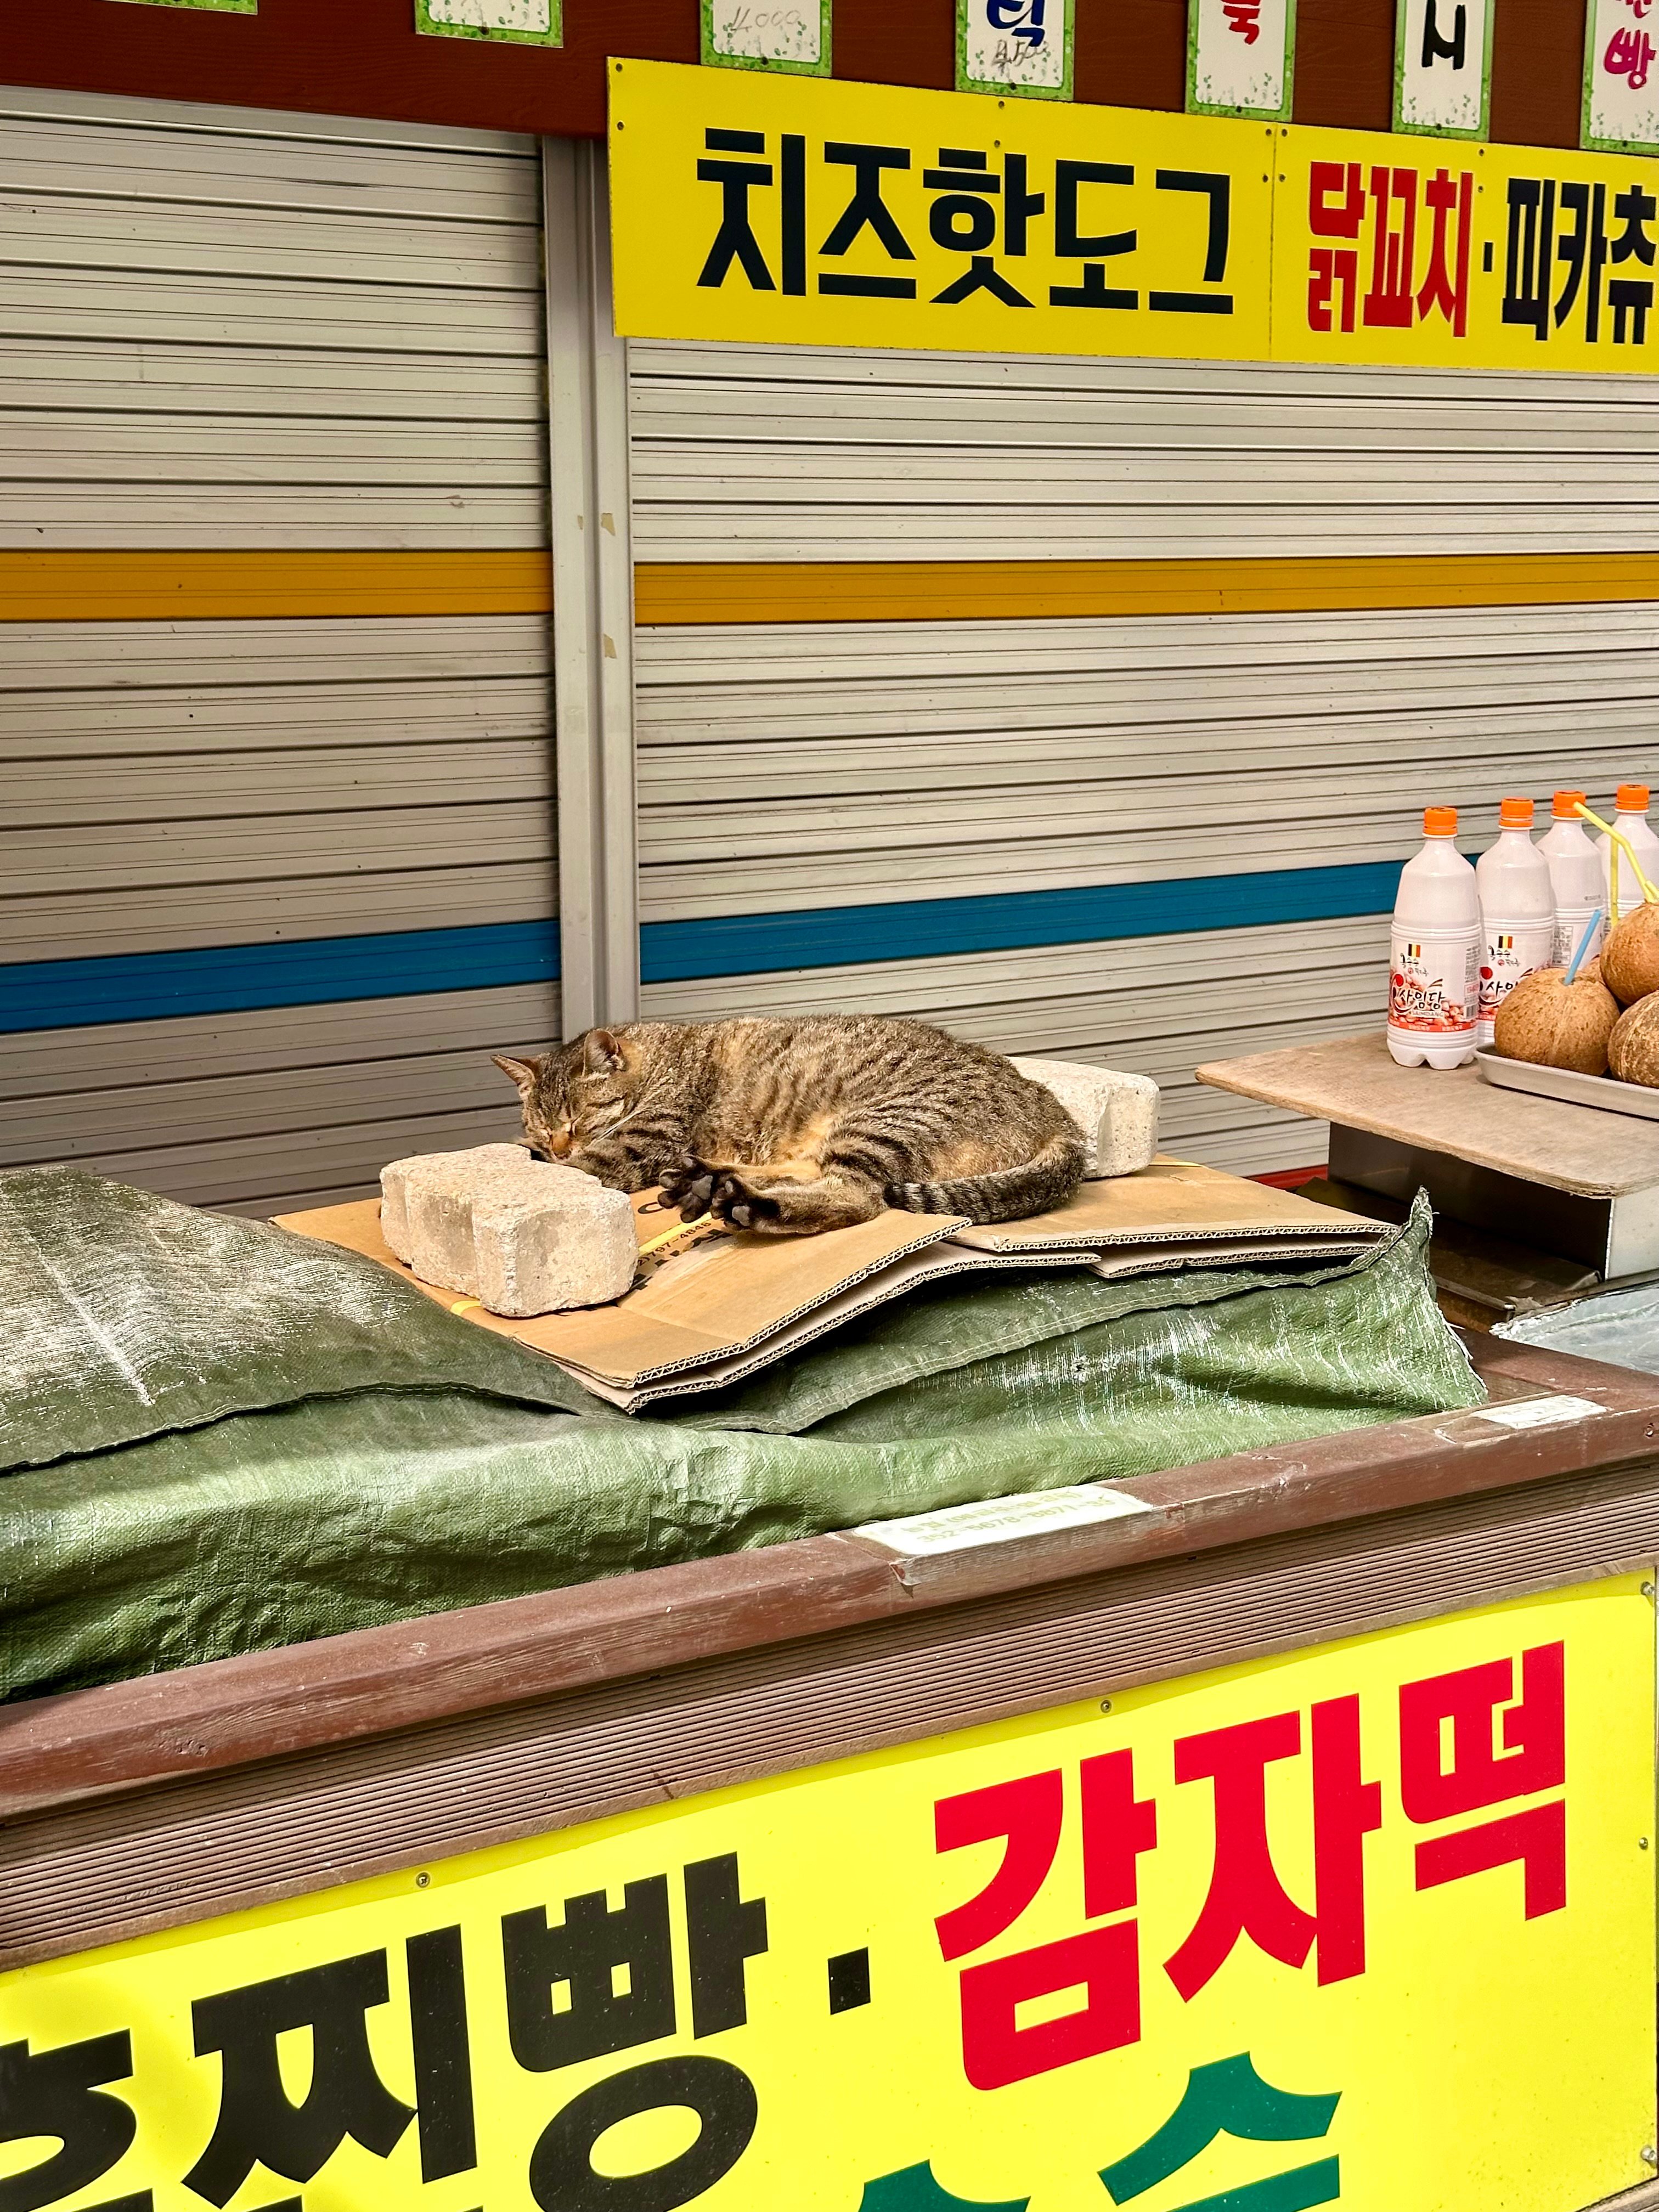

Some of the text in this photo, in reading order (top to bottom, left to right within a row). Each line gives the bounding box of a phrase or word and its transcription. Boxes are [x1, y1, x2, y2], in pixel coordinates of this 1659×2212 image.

[1604, 0, 1657, 90] 빵
[696, 127, 1234, 315] 치즈핫도그
[1307, 161, 1474, 338] 닭꼬치
[1502, 177, 1657, 345] 피카츄
[1400, 989, 1446, 1009] 사임당
[933, 1639, 1567, 2091] 감자떡
